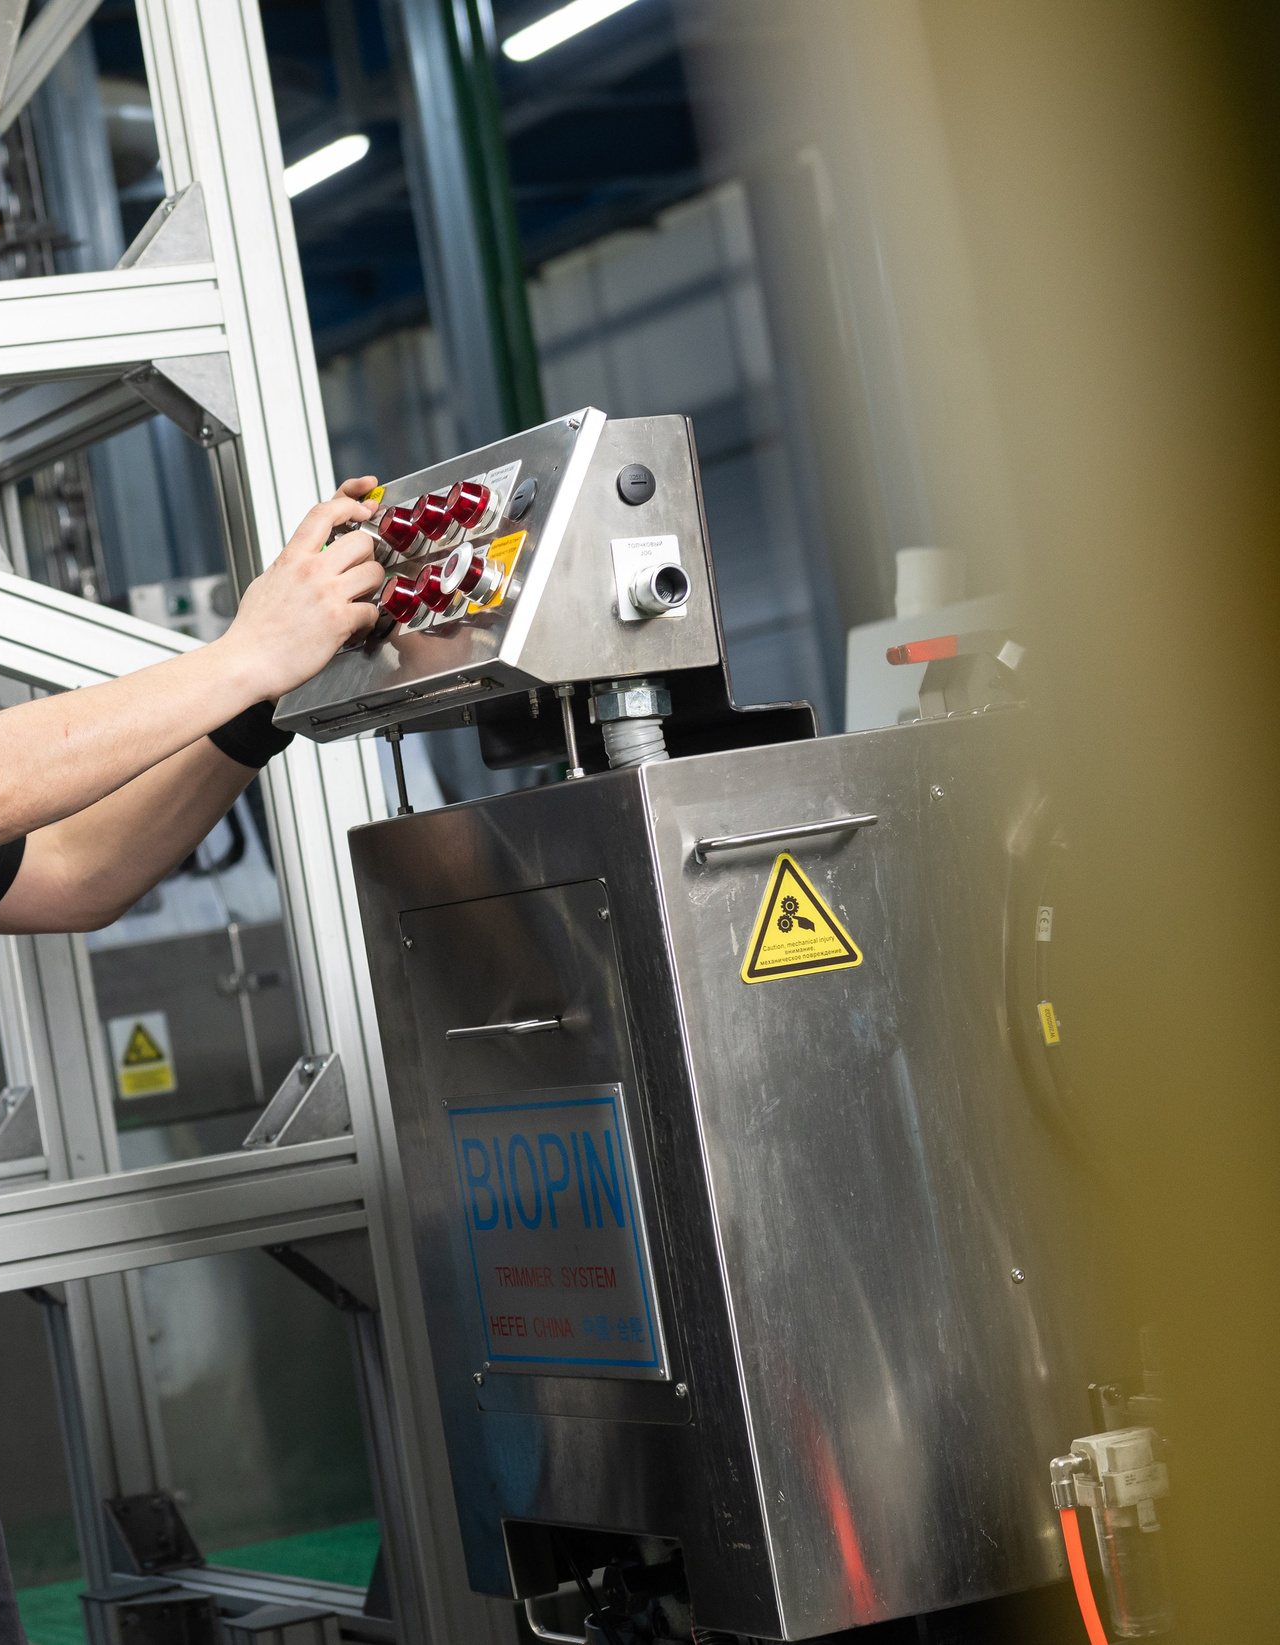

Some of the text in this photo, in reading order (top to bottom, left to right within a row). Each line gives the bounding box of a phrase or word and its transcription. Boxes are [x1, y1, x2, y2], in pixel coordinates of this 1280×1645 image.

[640, 549, 653, 557] JOG
[786, 938, 819, 948] mechanical
[818, 935, 835, 944] injury
[802, 948, 842, 959] повреждение
[461, 1129, 626, 1231] BIOPIN
[494, 1266, 618, 1289] TRIMMER SYSTEM
[490, 1315, 527, 1338] HEFEI
[533, 1316, 574, 1338] CHINA
